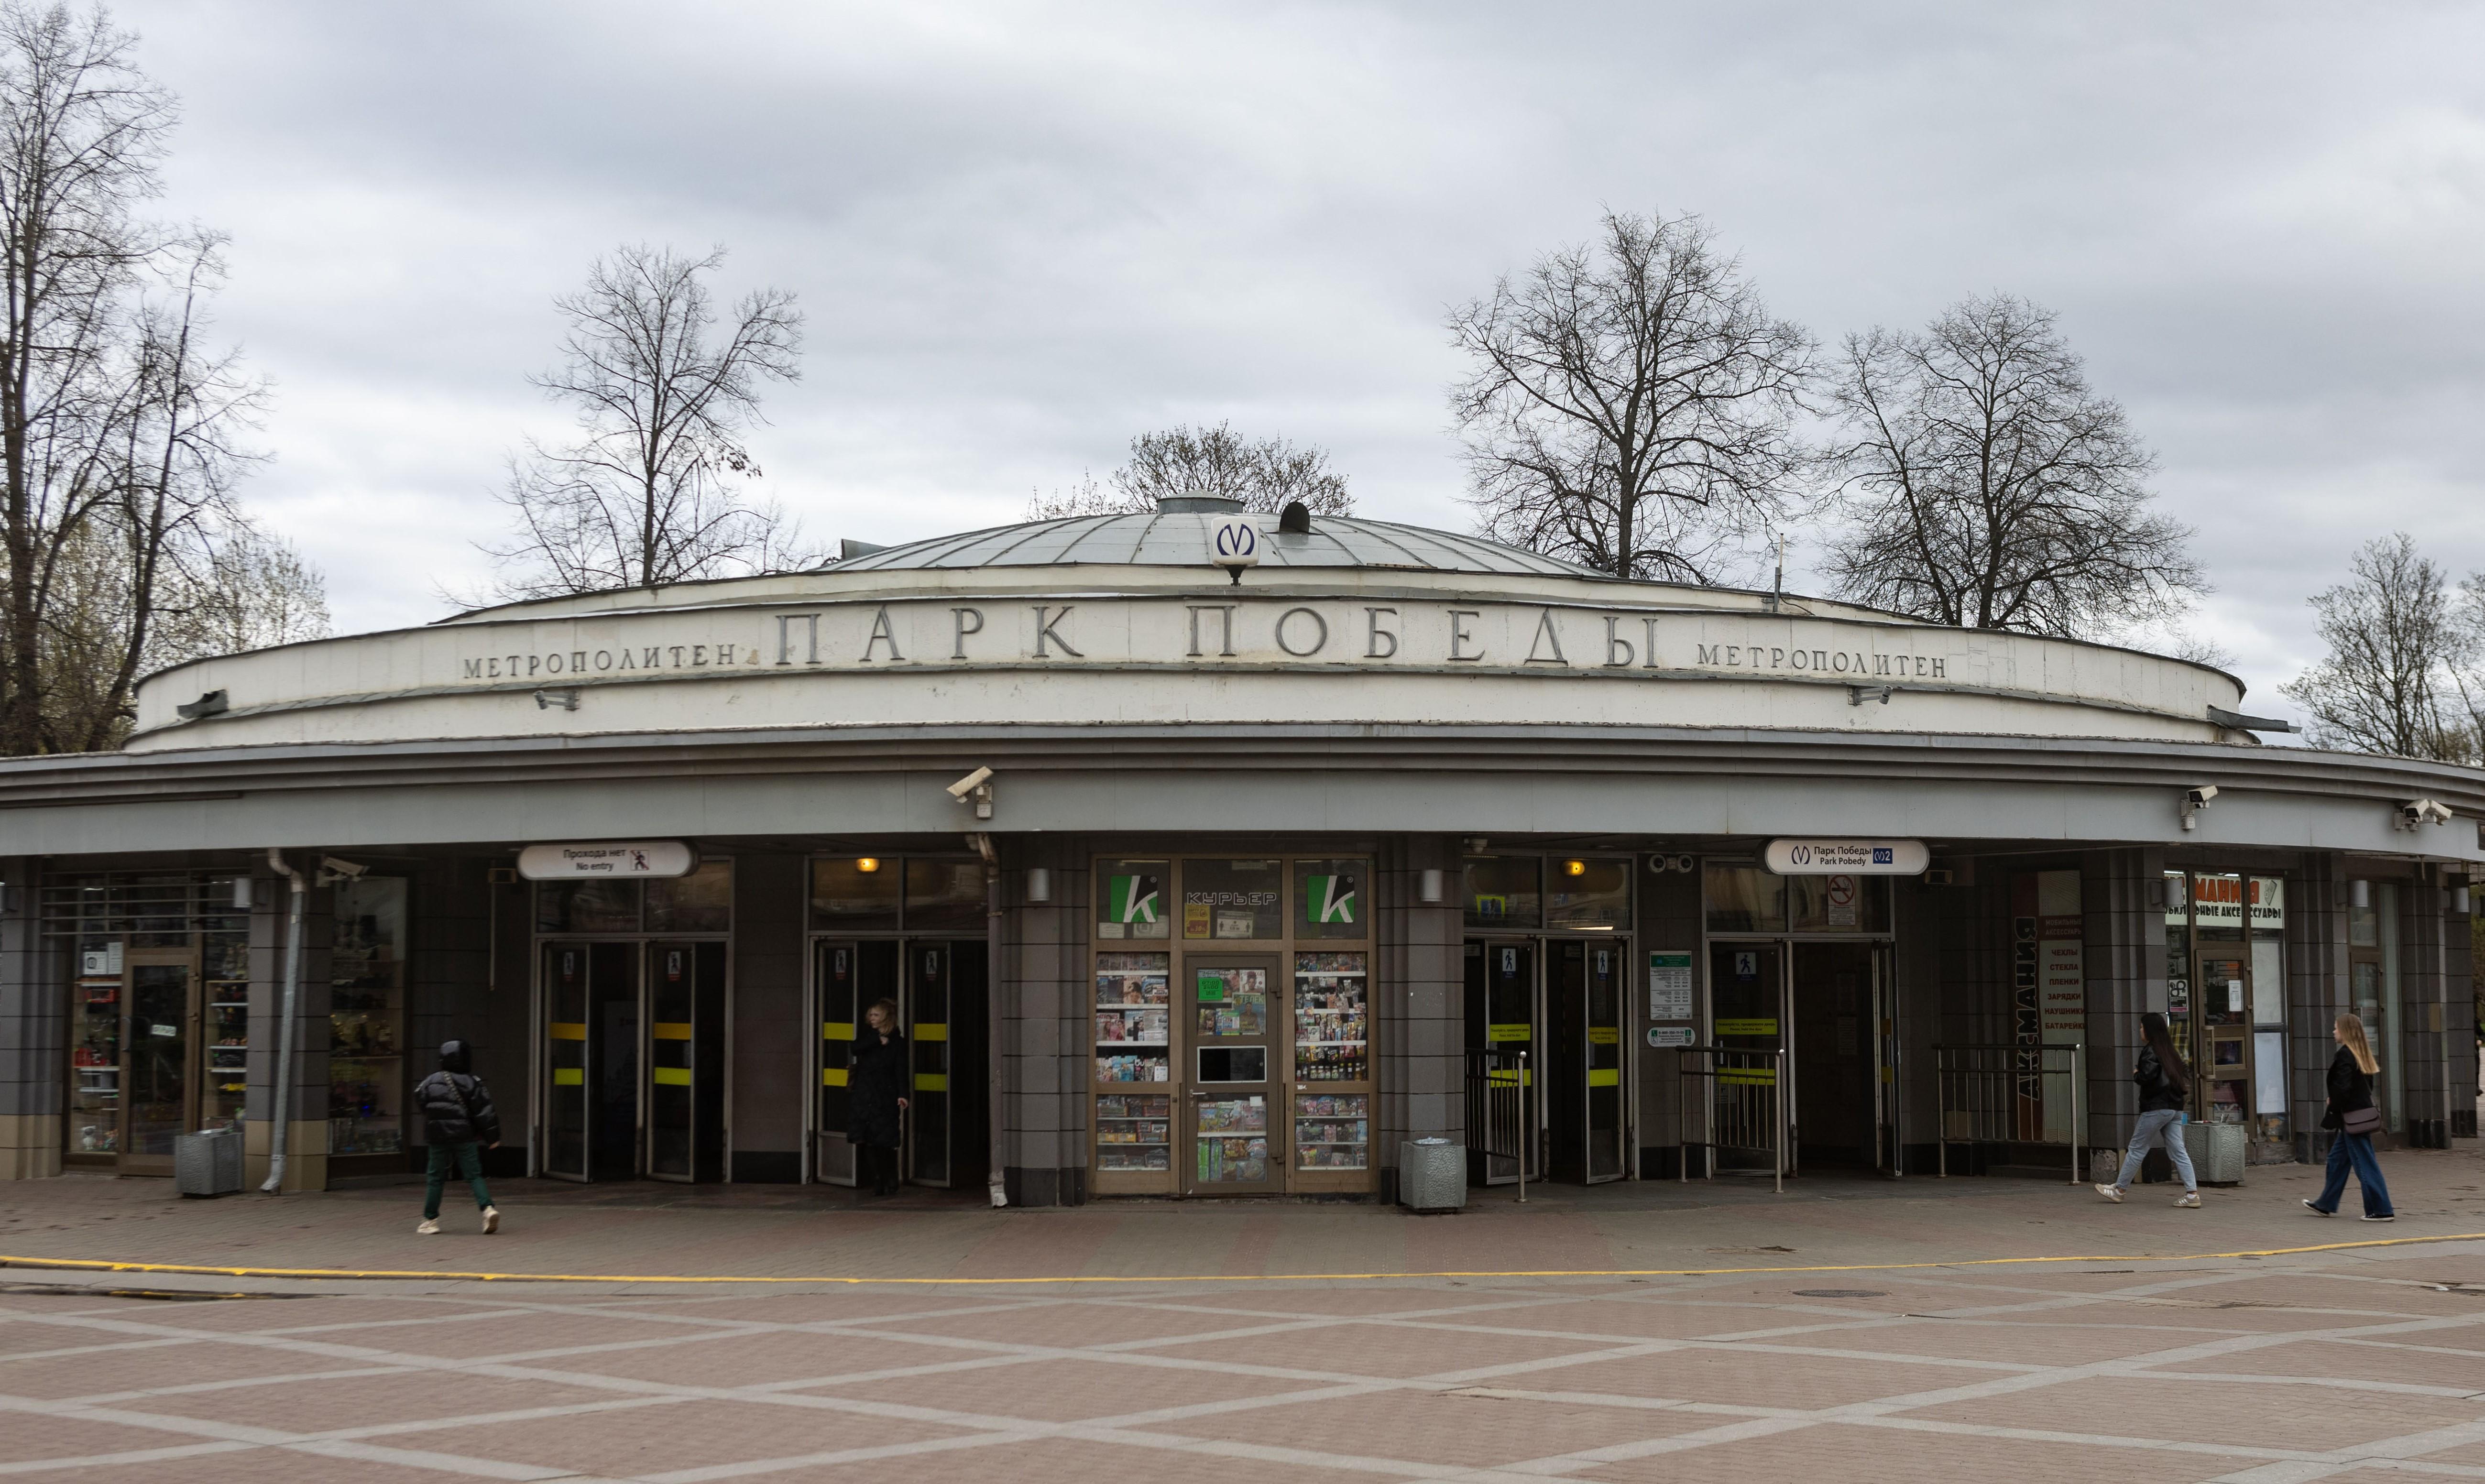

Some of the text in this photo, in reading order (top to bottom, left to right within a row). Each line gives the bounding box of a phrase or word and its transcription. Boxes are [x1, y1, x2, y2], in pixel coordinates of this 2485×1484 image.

[776, 604, 1659, 668] ПАРК ПОБЕДЫ
[464, 644, 735, 678] МЕТРОПОЛИТЕН
[1697, 644, 1946, 678] МЕТРОПОЛИТЕН
[563, 849, 607, 859] Прохода
[1814, 847, 1836, 856] Парк
[1838, 846, 1872, 856] Победы
[591, 862, 614, 872] entry
[1820, 857, 1866, 866] Park Pobedy
[1187, 892, 1277, 905] КУРЬЕР
